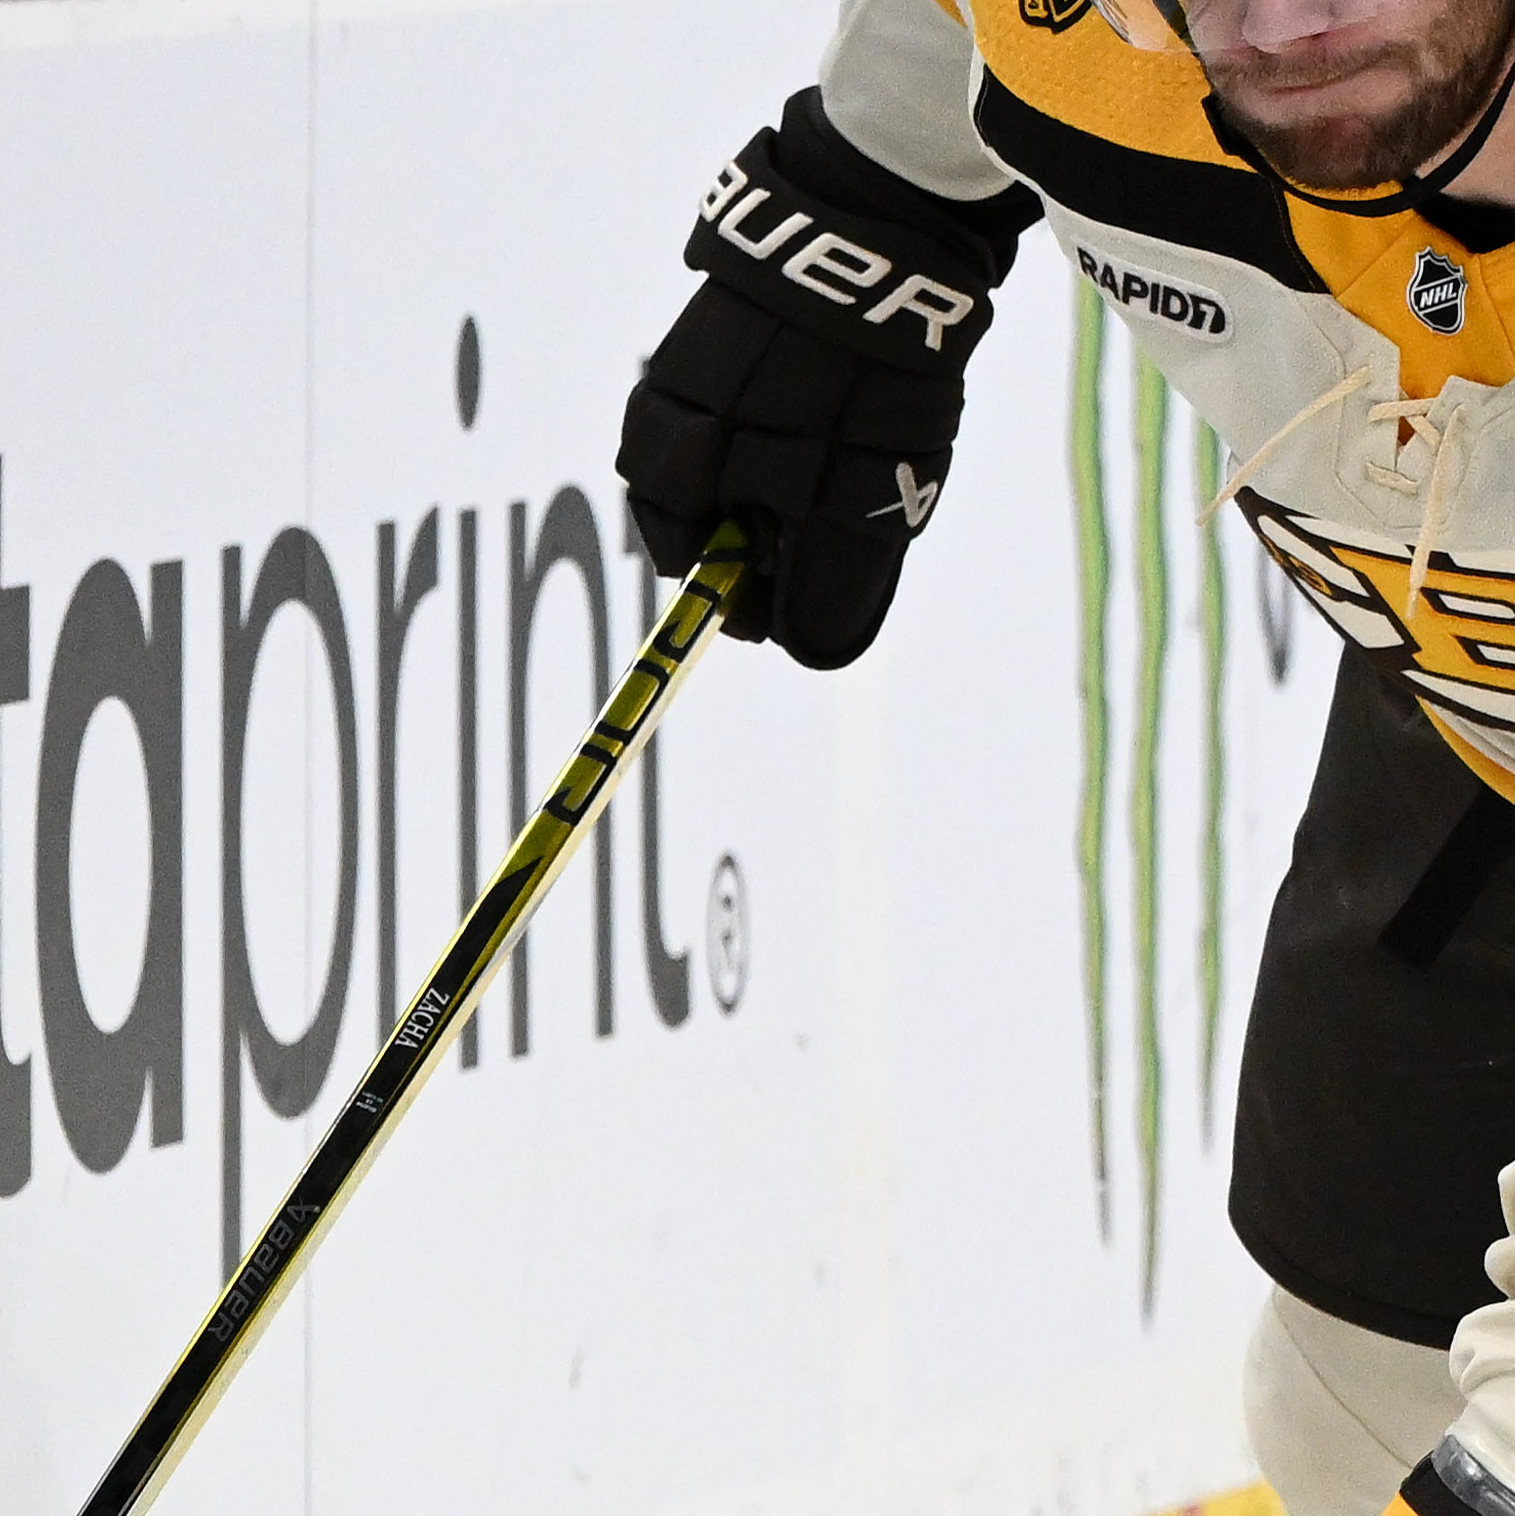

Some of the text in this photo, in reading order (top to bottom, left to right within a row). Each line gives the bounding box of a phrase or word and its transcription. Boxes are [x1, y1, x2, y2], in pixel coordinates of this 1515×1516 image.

[697, 160, 974, 352] AUER
[1419, 282, 1457, 308] NHL
[395, 987, 450, 1049] ZACHA
[207, 1219, 295, 1342] BAUER
